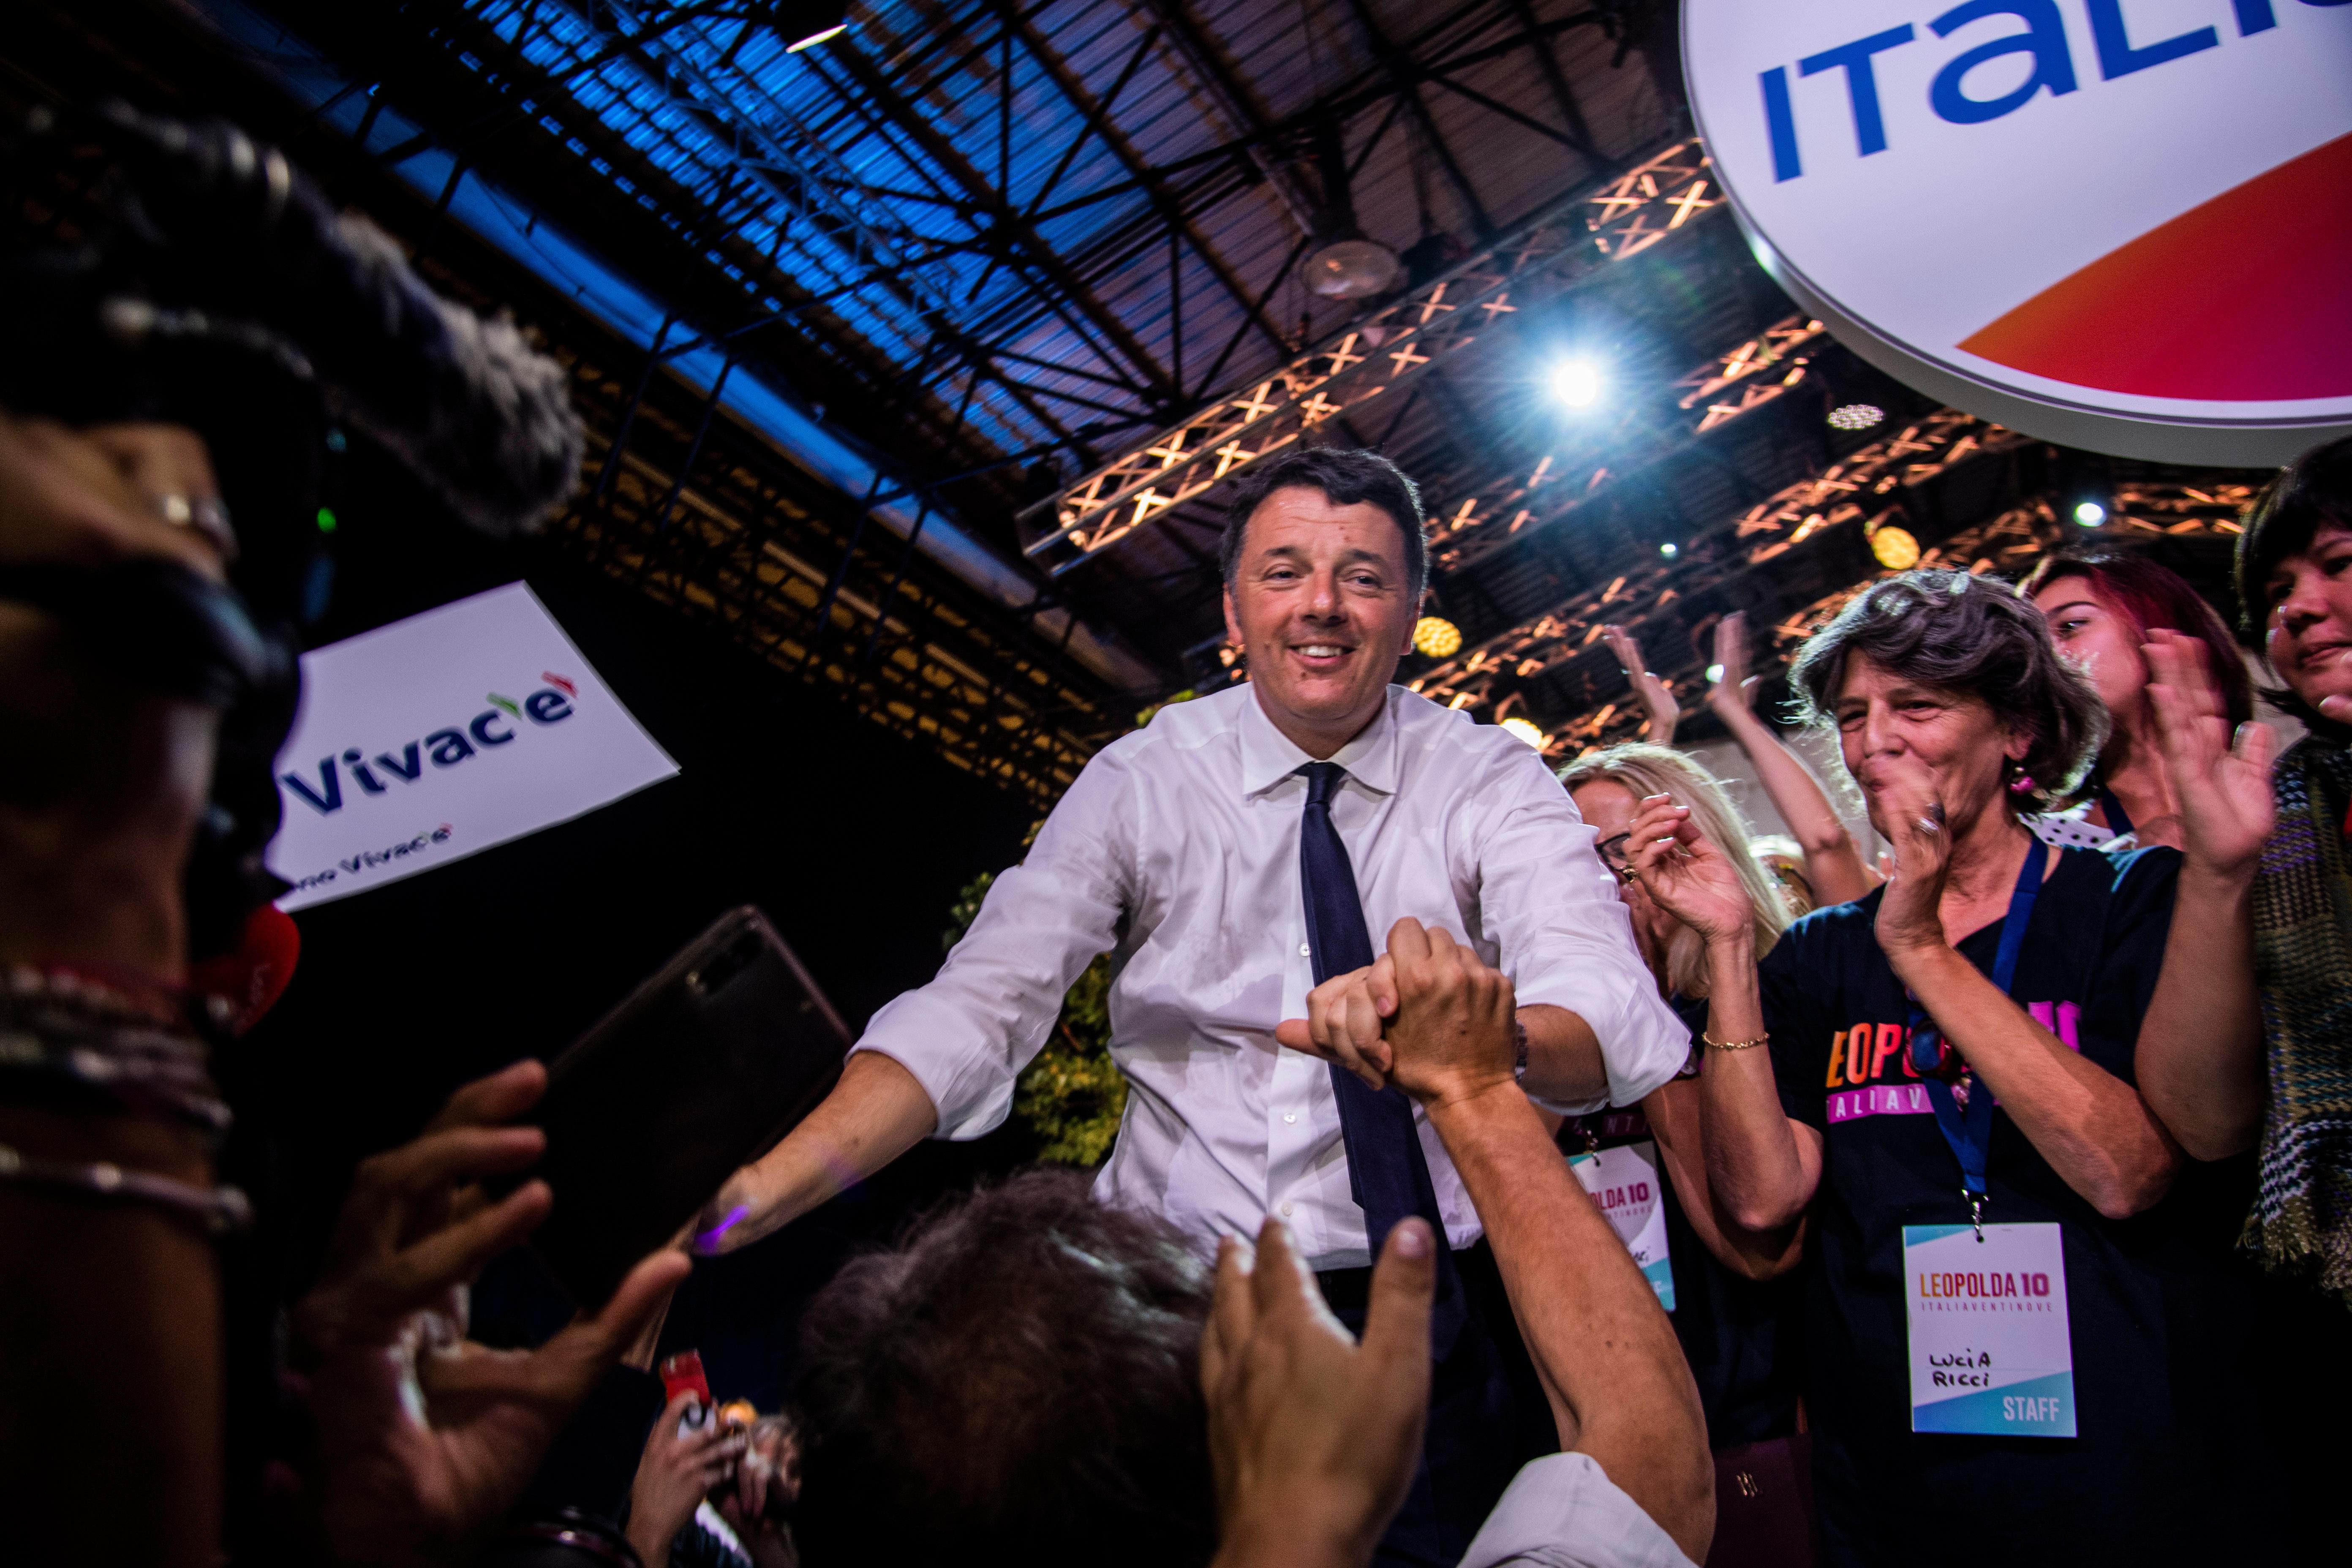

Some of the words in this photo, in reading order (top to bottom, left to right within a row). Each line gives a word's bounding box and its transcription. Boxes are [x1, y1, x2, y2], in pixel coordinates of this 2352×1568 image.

[1628, 1182, 1649, 1203] 10
[1919, 1271, 2017, 1298] LEOPOLDA
[2020, 1272, 2050, 1297] 10
[1920, 1301, 2052, 1312] ITALIAVENTINOVE
[2003, 1396, 2060, 1421] STAFF
